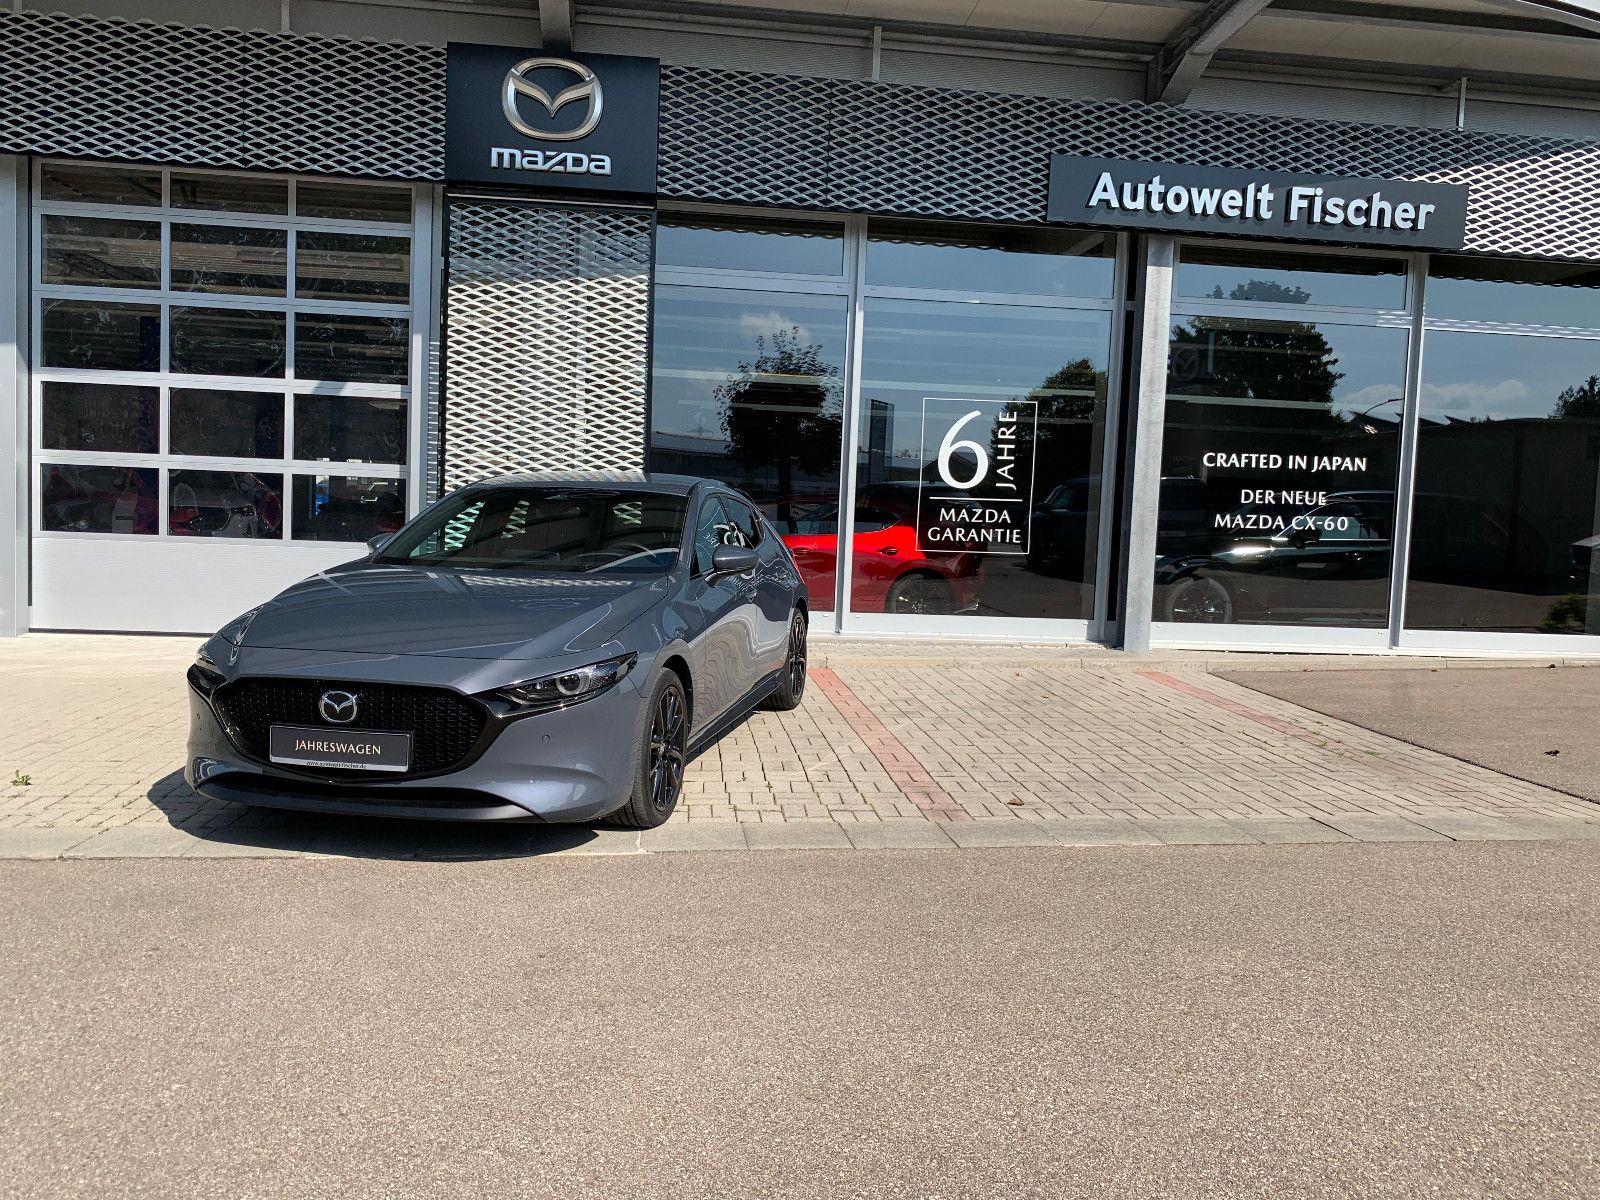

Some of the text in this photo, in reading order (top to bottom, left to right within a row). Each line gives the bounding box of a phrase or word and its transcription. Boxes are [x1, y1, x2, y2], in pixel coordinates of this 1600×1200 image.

[1086, 172, 1436, 231] Autowelt Fischer
[937, 410, 989, 490] 6
[995, 411, 1018, 491] JAHRE
[1202, 452, 1283, 469] CRAFTED
[1288, 455, 1307, 470] IN
[1311, 455, 1368, 472] JAPAN
[1240, 489, 1327, 506] DER NEUE
[939, 507, 1012, 524] MAZDA
[1214, 513, 1349, 531] MAZDA CX-60
[927, 527, 1021, 543] GARANTIE
[295, 739, 381, 755] JAHRESWAGEN
